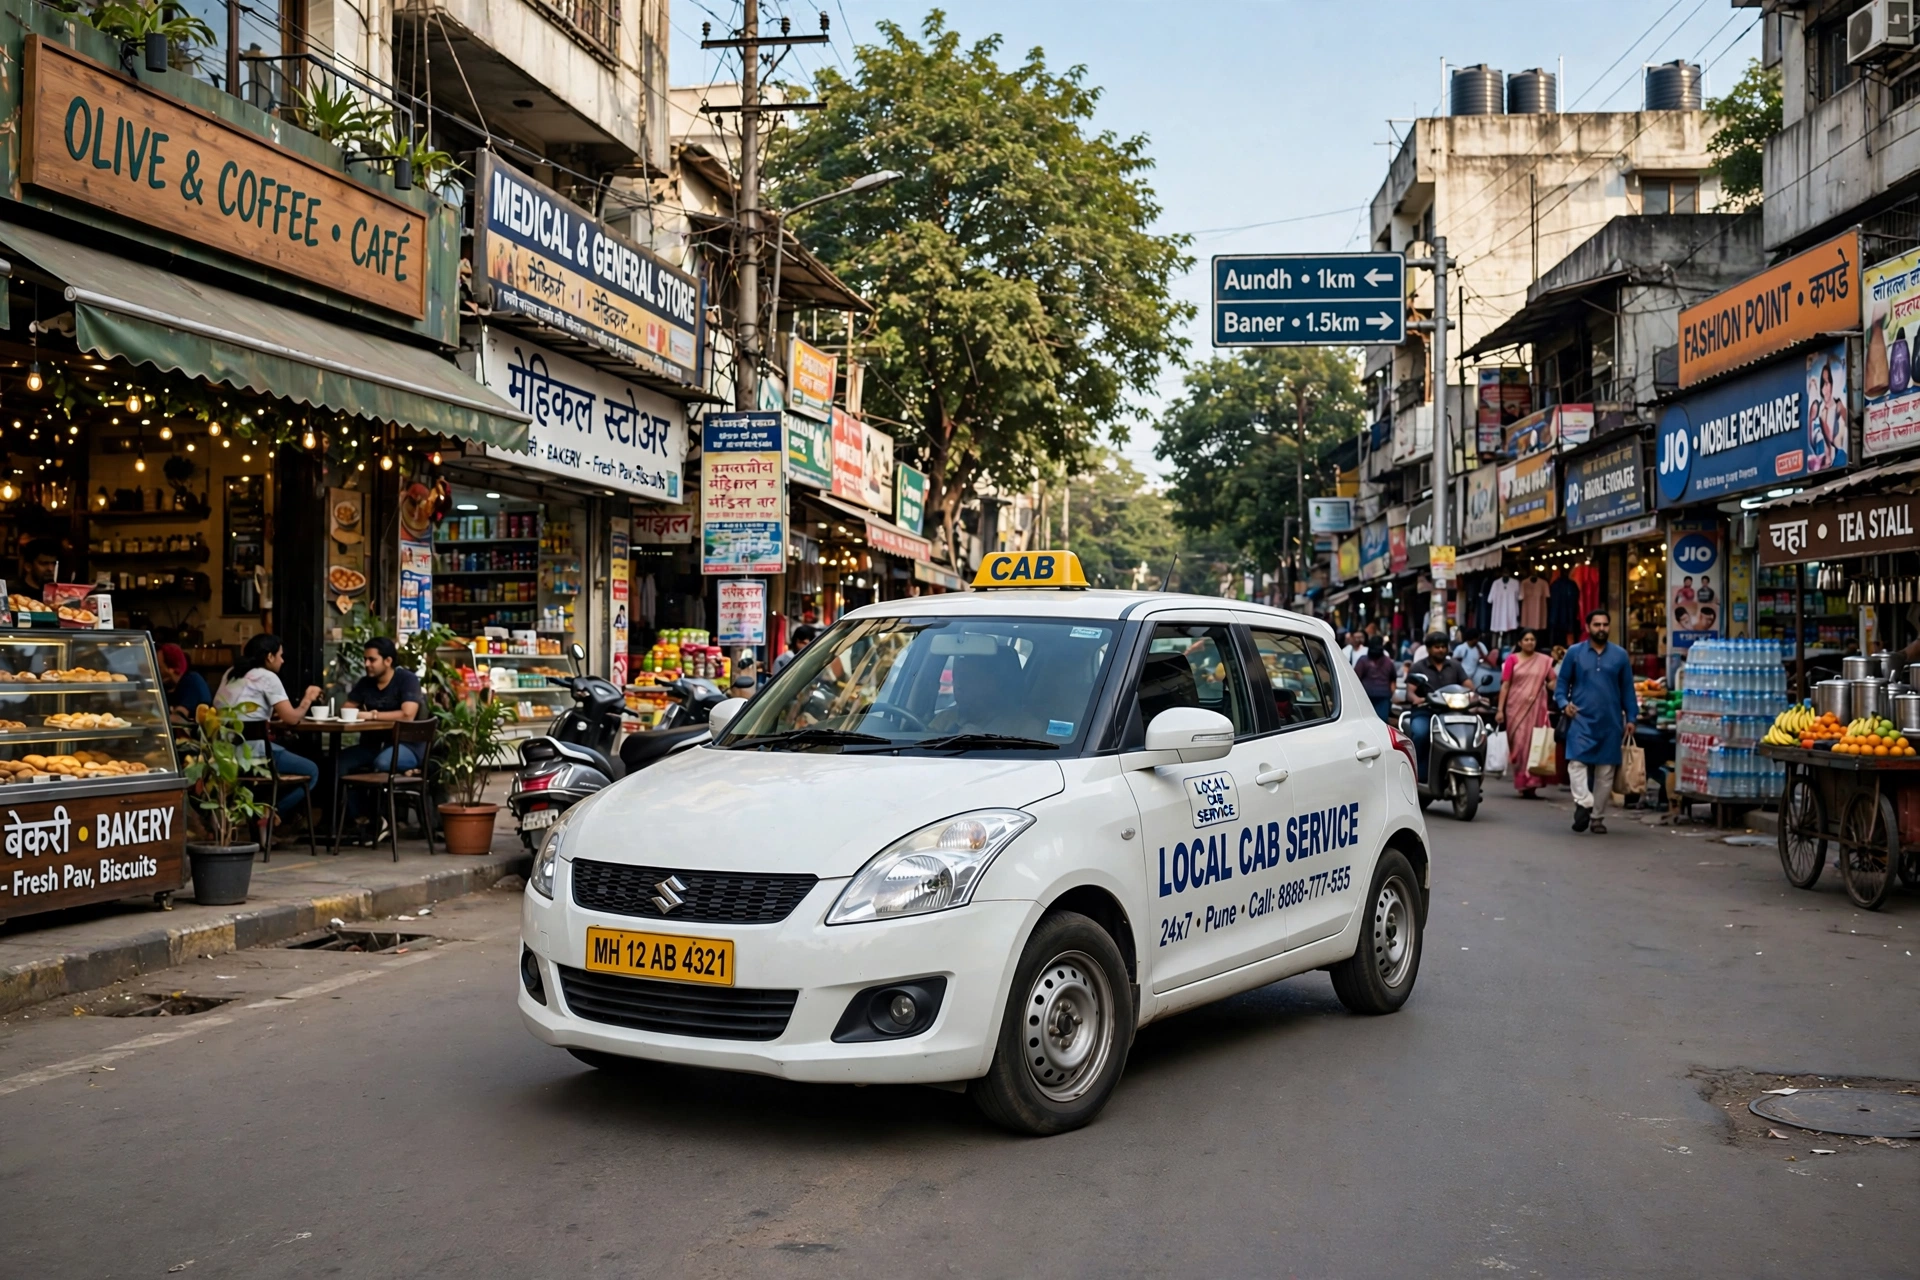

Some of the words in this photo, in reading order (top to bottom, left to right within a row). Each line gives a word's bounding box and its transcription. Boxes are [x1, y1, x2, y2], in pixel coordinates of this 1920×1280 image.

[64, 96, 169, 189] OLIVE
[180, 149, 203, 205] &
[218, 160, 321, 247] COFFEE
[351, 217, 411, 281] CAFÉ
[493, 171, 572, 260] MEDICAL
[576, 222, 589, 268] &
[592, 232, 655, 304] GENERAL
[657, 269, 695, 326] STORE
[1223, 268, 1292, 290] Aundh
[1317, 268, 1355, 289] 1km
[1224, 311, 1285, 333] Baner
[1306, 311, 1359, 332] 1.5km
[1684, 303, 1741, 364] FASHION
[1745, 281, 1792, 338] POINT
[604, 387, 671, 458] स्टोअर
[1700, 412, 1737, 457] MOBILE
[1739, 391, 1800, 443] RECHARGE
[1660, 428, 1689, 476] JIO
[1679, 546, 1712, 562] JIO
[1769, 519, 1809, 555] चहा
[1838, 510, 1865, 543] TEA
[1869, 503, 1914, 539] STALL
[990, 555, 1055, 581] CAB
[4, 805, 71, 859] बेकरी
[96, 806, 174, 849] BAKERY
[1159, 833, 1233, 898] LOCAL
[1239, 821, 1280, 875] CAB
[1286, 802, 1359, 863] SERVICE
[13, 866, 58, 897] Fresh
[64, 864, 96, 889] Pav,
[100, 854, 157, 884] Biscuits
[1159, 911, 1193, 947] 24x7
[1205, 904, 1237, 933] Pune
[1249, 888, 1275, 919] Call:
[1277, 865, 1351, 910] 8888-777-555
[594, 937, 620, 965] MH
[626, 940, 646, 968] 12
[650, 943, 676, 972] AB
[682, 946, 725, 977] 4321
